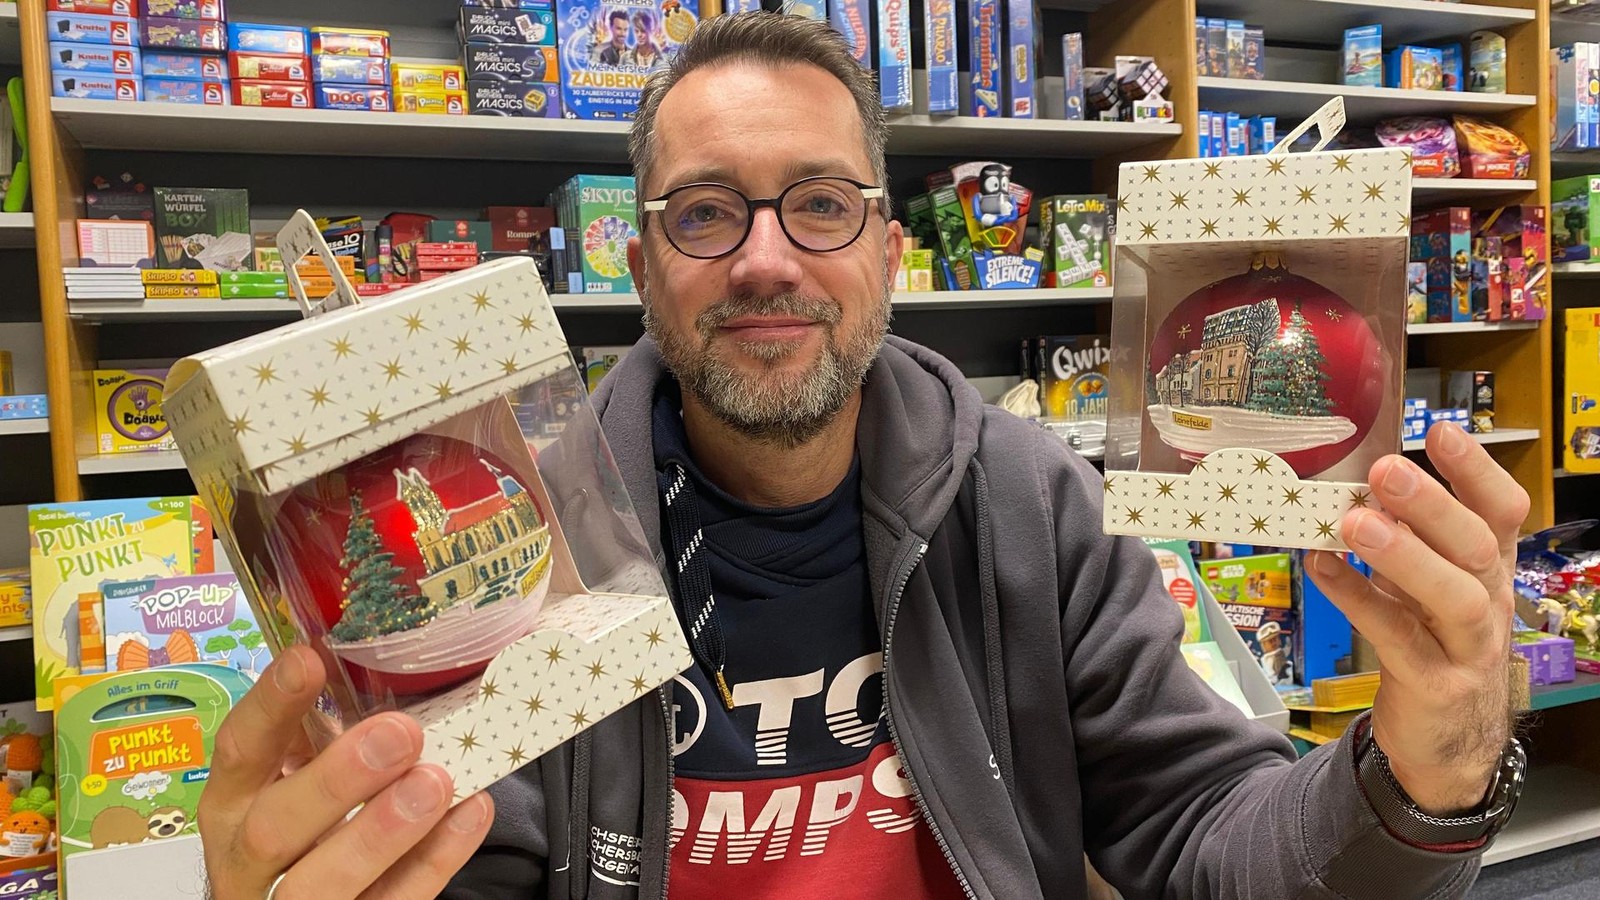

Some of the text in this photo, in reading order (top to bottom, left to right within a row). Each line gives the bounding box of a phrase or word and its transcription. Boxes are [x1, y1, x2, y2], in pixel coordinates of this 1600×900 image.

[471, 25, 517, 36] MAGICS
[475, 61, 521, 72] MAGICS
[328, 92, 366, 104] DOG
[476, 98, 523, 109] MAGICS
[581, 186, 636, 207] SKYJO
[165, 212, 207, 228] BOX
[344, 232, 360, 245] 10
[987, 255, 1024, 273] EXTREME
[985, 266, 1036, 289] SILENCE!
[1065, 397, 1108, 416] 10 JAH
[36, 513, 125, 557] PUNKT
[57, 540, 144, 583] PUNKT
[139, 584, 234, 615] POP-UP
[156, 607, 225, 630] MALBLOCK
[107, 679, 180, 698] Alles im Griff
[103, 755, 125, 773] zu
